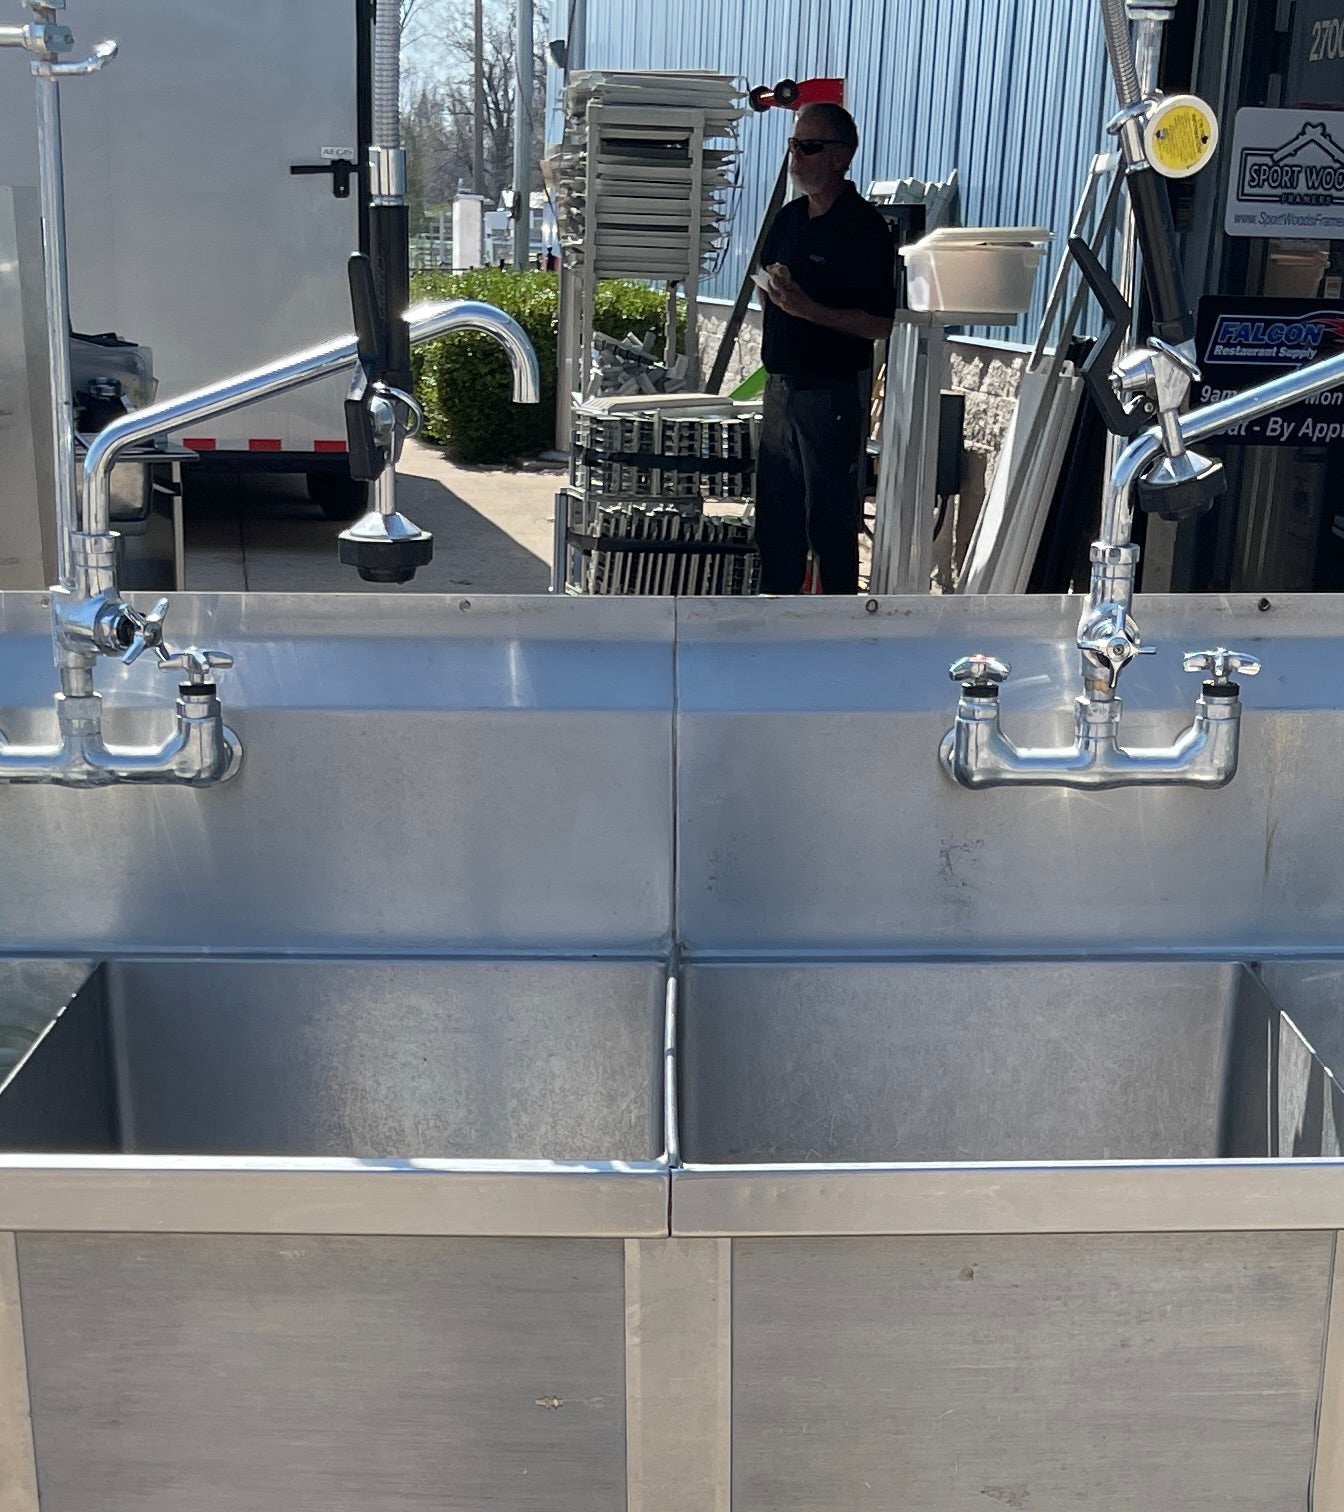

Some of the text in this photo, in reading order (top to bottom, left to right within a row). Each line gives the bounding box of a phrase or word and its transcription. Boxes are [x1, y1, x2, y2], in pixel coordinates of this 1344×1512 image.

[1249, 165, 1302, 189] SPORT
[1218, 322, 1325, 345] FALCON
[1214, 345, 1318, 360] Restaurant Supply
[1266, 417, 1296, 441] By
